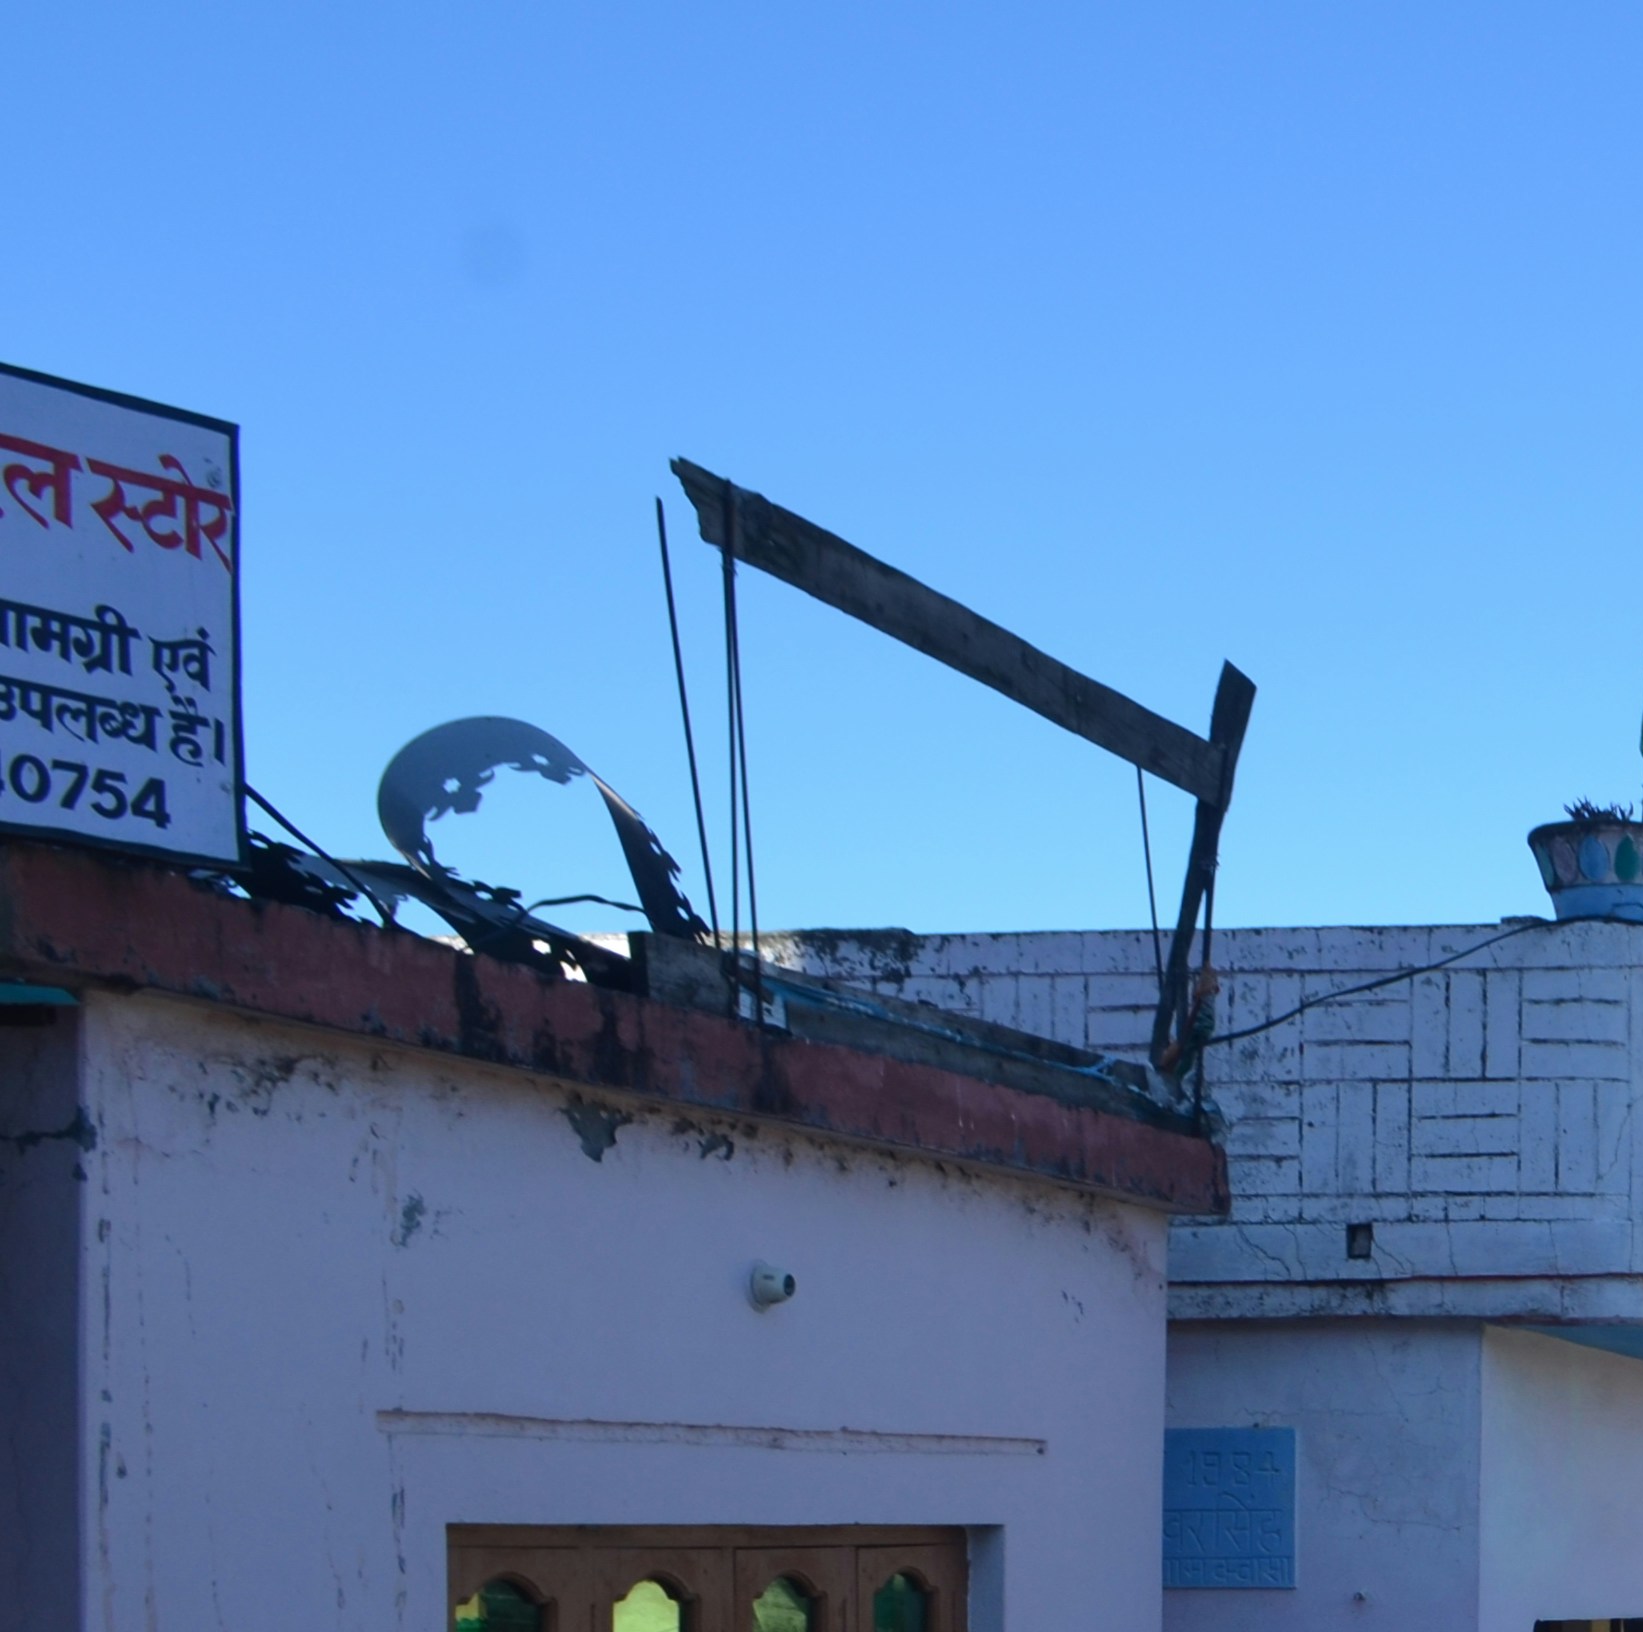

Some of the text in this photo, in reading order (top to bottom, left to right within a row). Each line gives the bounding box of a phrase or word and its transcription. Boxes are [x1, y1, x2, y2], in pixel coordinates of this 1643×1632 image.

[0, 433, 233, 573] ल स्टोर
[150, 628, 217, 693] एवं
[0, 749, 172, 830] 0754
